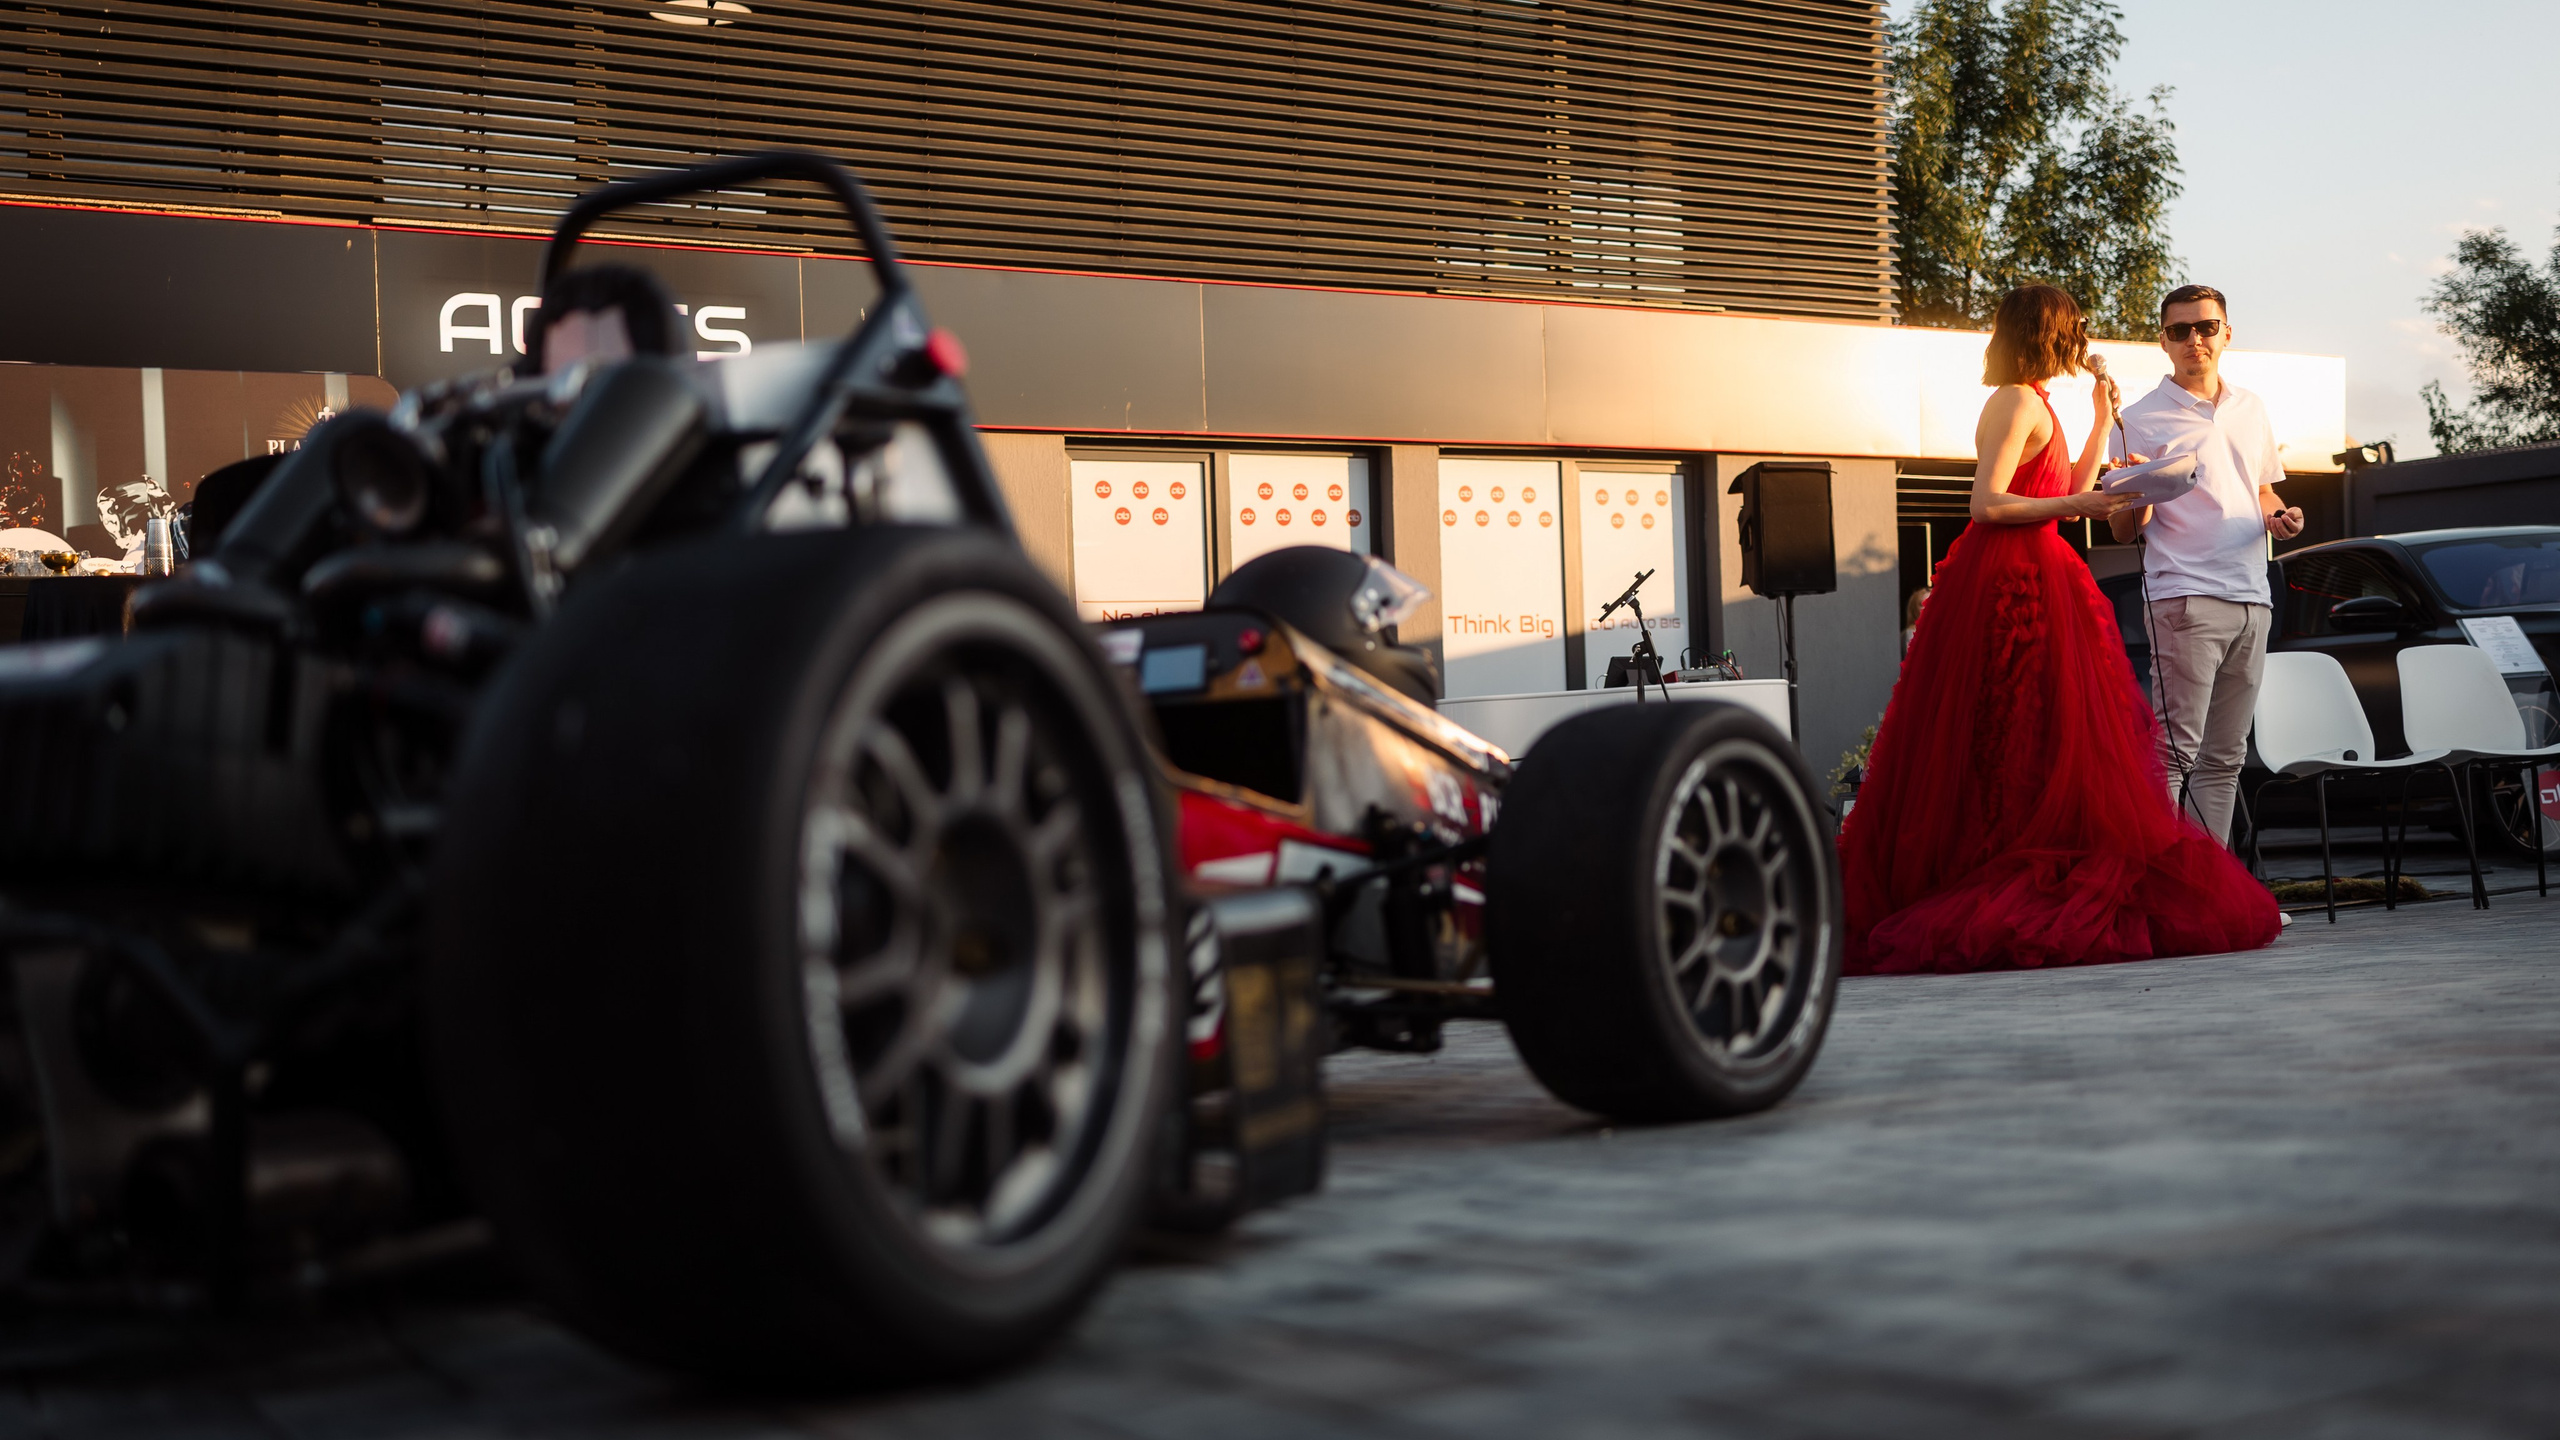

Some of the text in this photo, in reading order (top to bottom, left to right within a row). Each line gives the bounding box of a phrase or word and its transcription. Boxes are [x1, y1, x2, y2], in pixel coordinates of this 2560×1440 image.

[1448, 614, 1555, 639] Think Big
[1660, 617, 1681, 629] BIG
